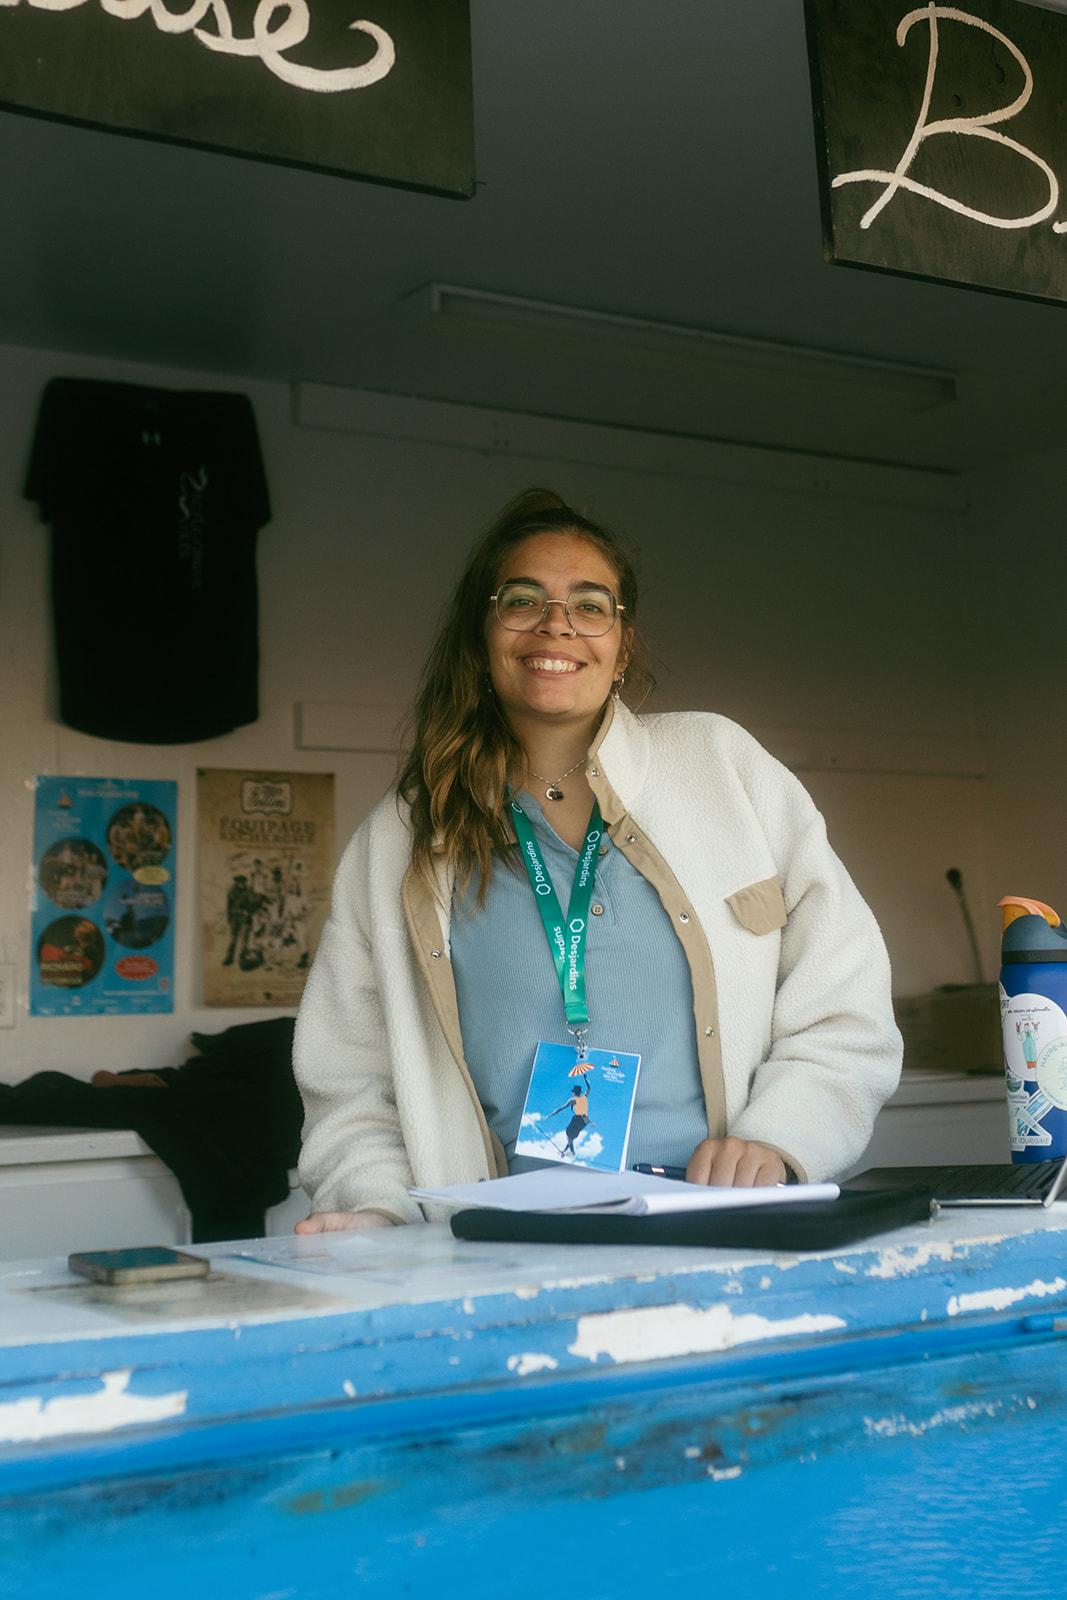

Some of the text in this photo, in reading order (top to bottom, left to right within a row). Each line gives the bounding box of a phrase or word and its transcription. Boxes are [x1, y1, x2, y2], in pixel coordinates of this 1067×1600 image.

[526, 841, 543, 883] Desjardins
[579, 844, 596, 888] Desjardins
[568, 935, 581, 991] Desjardins
